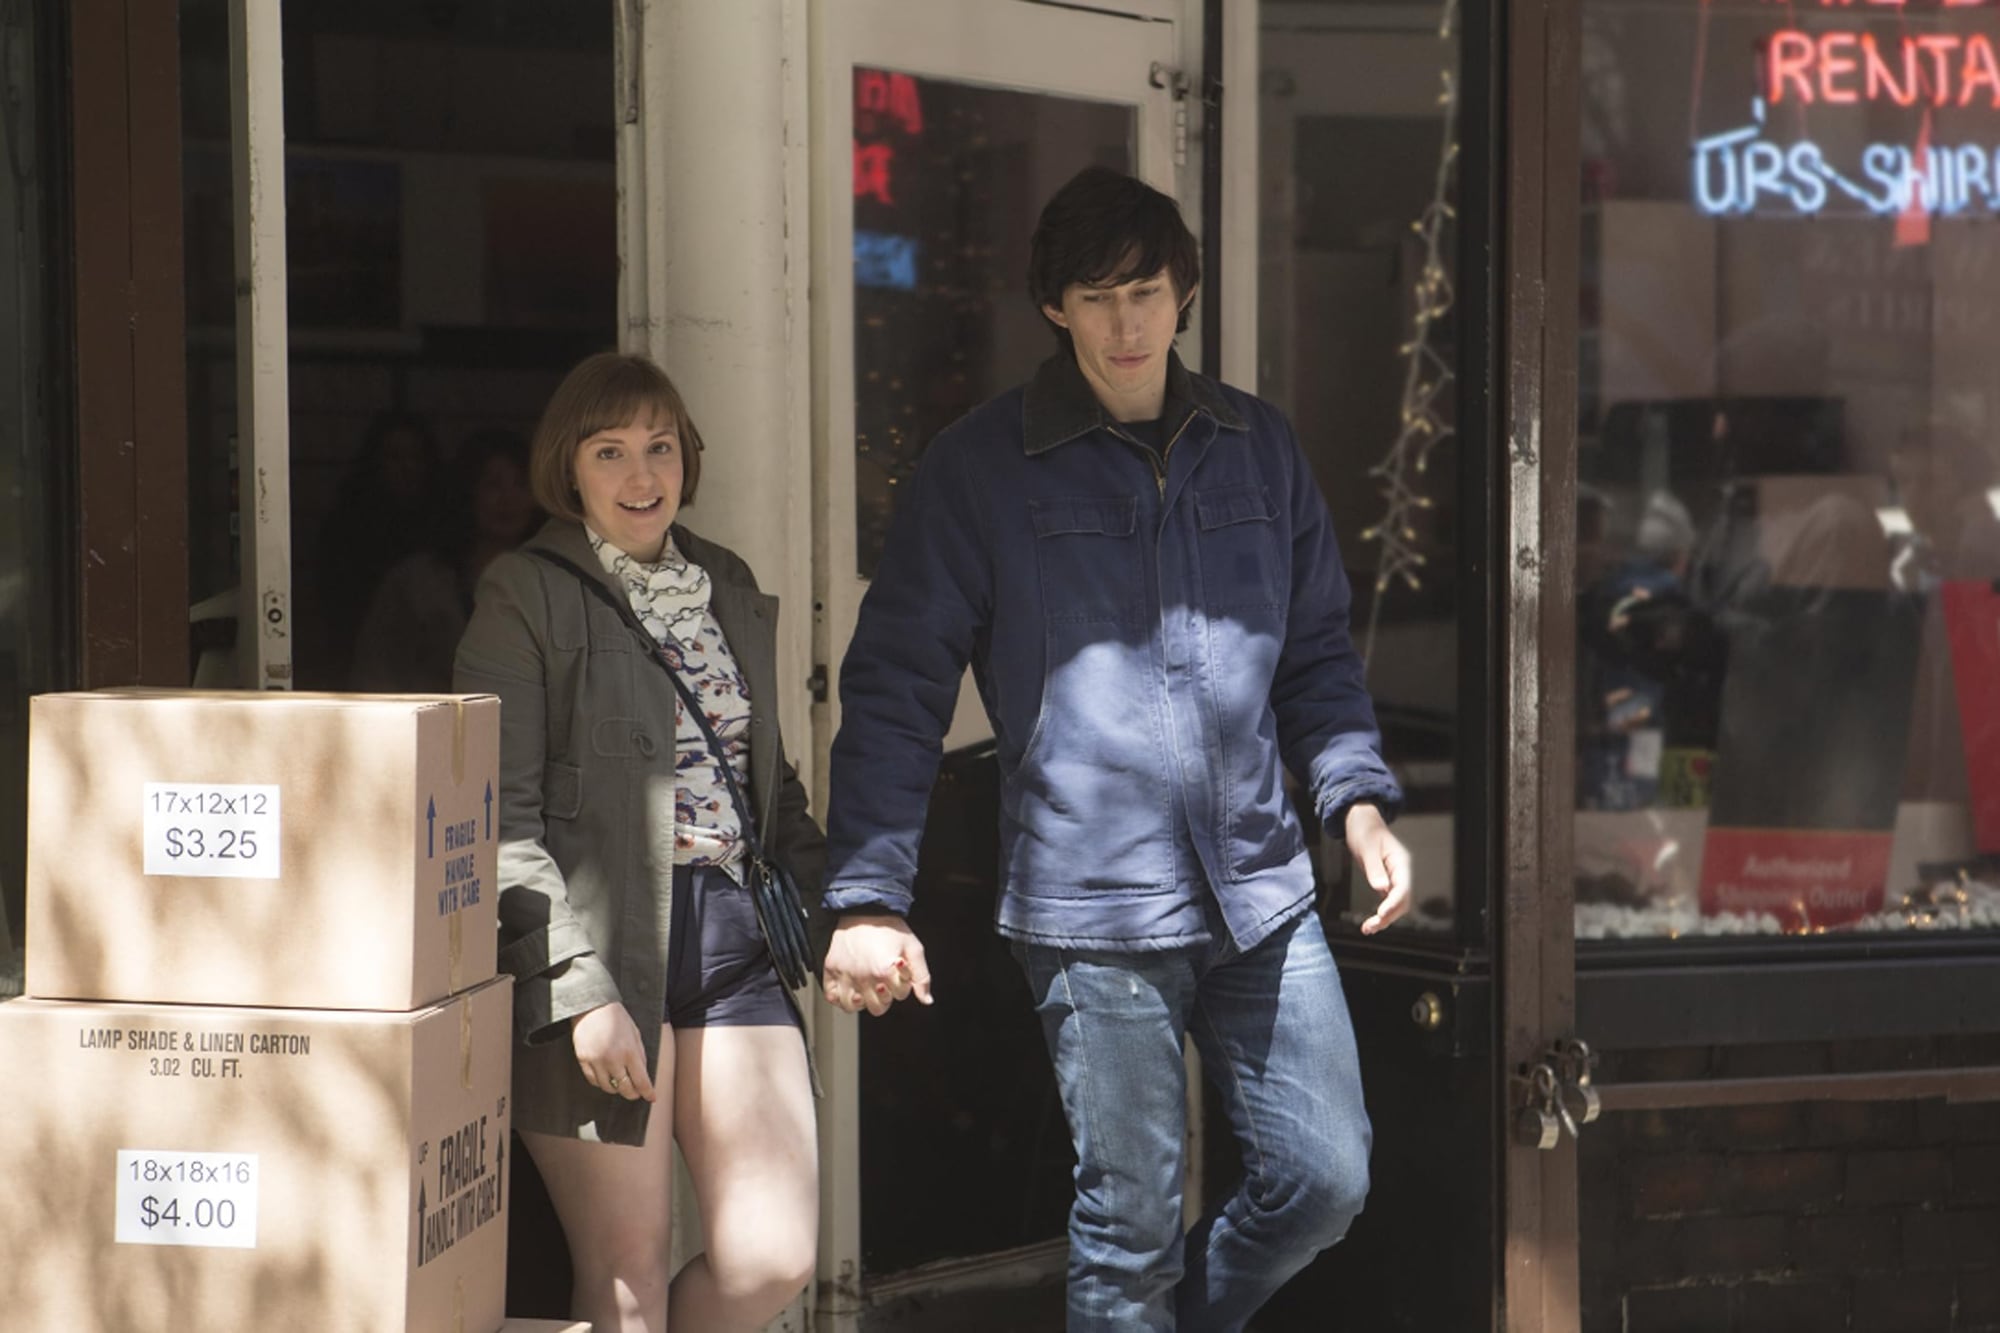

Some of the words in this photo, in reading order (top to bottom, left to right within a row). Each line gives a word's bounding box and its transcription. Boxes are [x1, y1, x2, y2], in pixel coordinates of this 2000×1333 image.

[1862, 143, 2000, 215] SHIR
[151, 791, 267, 815] 17x12x12
[165, 826, 257, 860] $3.25
[445, 819, 476, 852] FRAGILE
[445, 853, 474, 886] HANDLE
[438, 886, 458, 917] WITH
[462, 878, 480, 908] CARE
[80, 1028, 122, 1049] LAMP
[128, 1030, 178, 1051] SHADE
[183, 1032, 195, 1052] &
[200, 1032, 244, 1053] LINEN
[250, 1033, 310, 1055] CARTON
[150, 1057, 180, 1076] 3.02
[191, 1058, 216, 1077] CU.
[221, 1058, 243, 1078] FT.
[130, 1159, 250, 1184] 18x18x16
[439, 1114, 487, 1203] FRAGILE
[140, 1195, 236, 1230] $4.00
[425, 1199, 456, 1264] HANDLE
[456, 1187, 476, 1243] WITH
[476, 1173, 497, 1228] CARE
